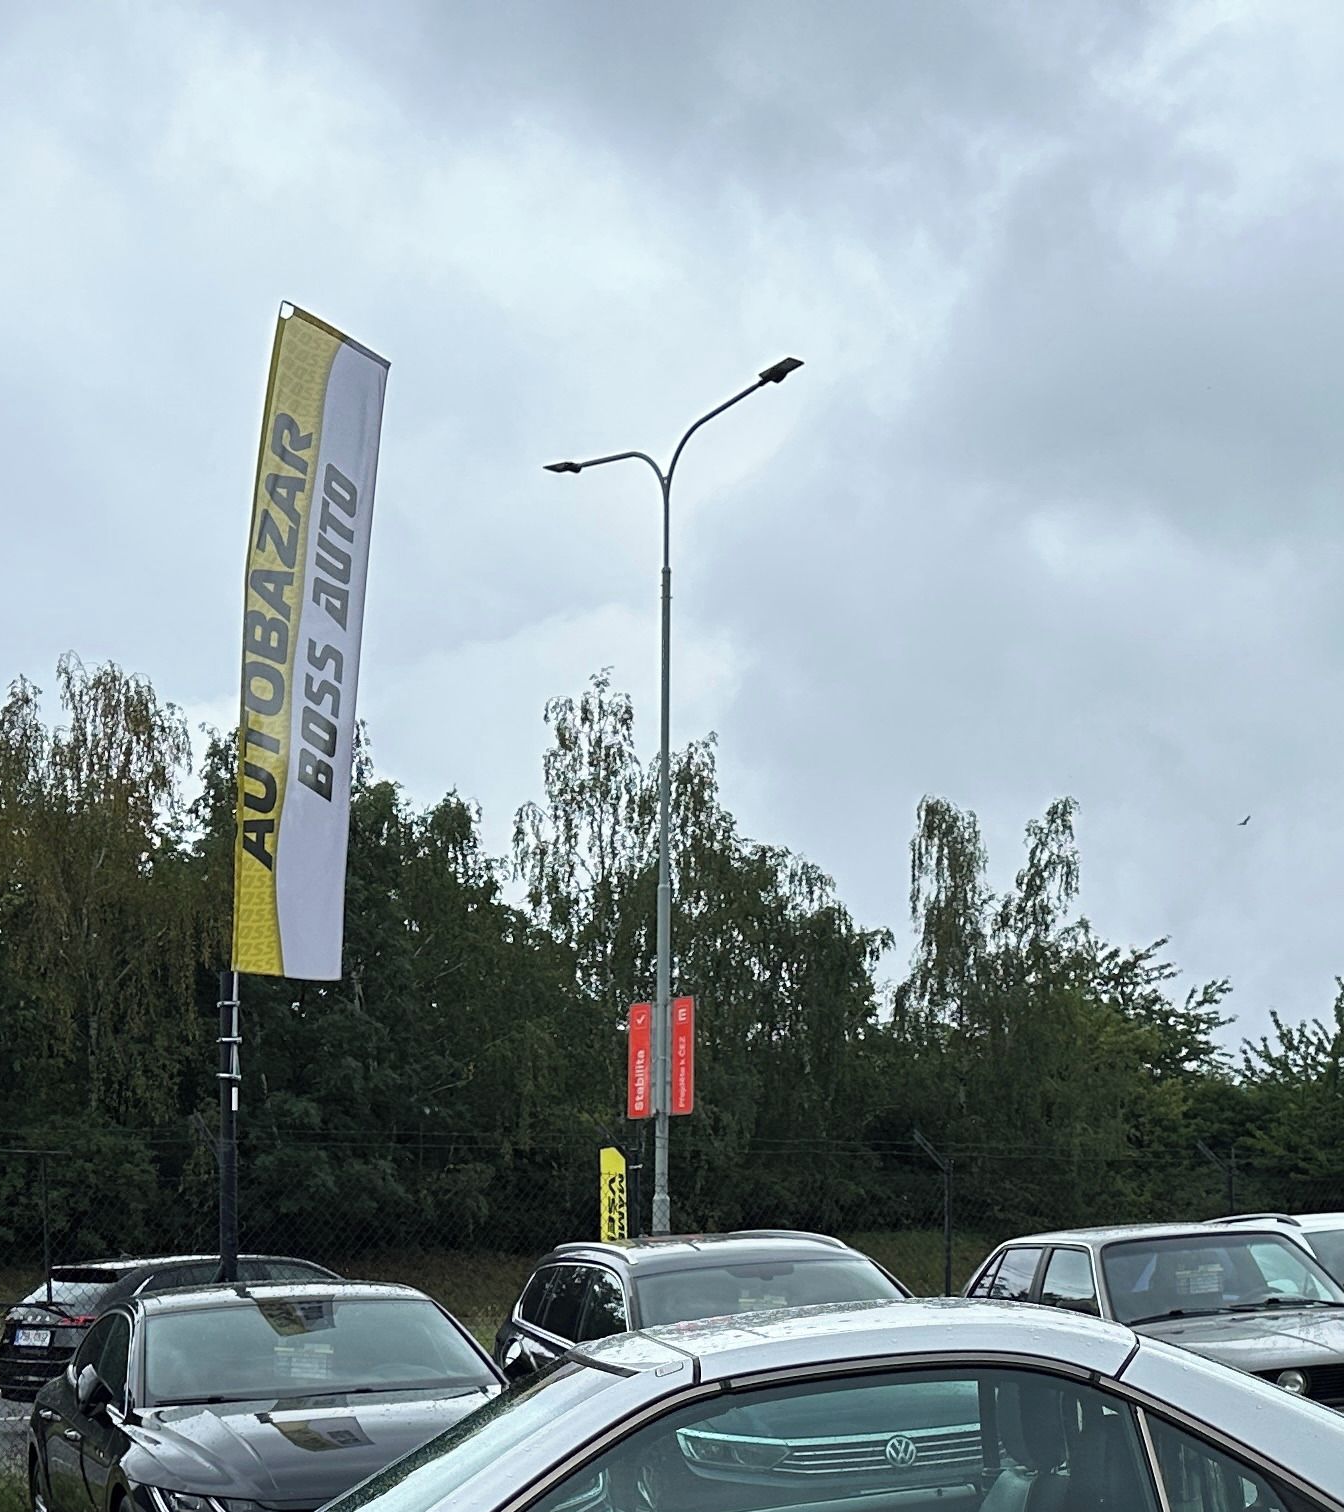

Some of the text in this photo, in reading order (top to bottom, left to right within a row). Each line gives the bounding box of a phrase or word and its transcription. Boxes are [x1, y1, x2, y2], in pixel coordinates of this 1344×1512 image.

[241, 412, 314, 872] AUTOBAZAR
[298, 463, 359, 802] BOSS AUTO
[634, 1050, 645, 1112] Stabilita
